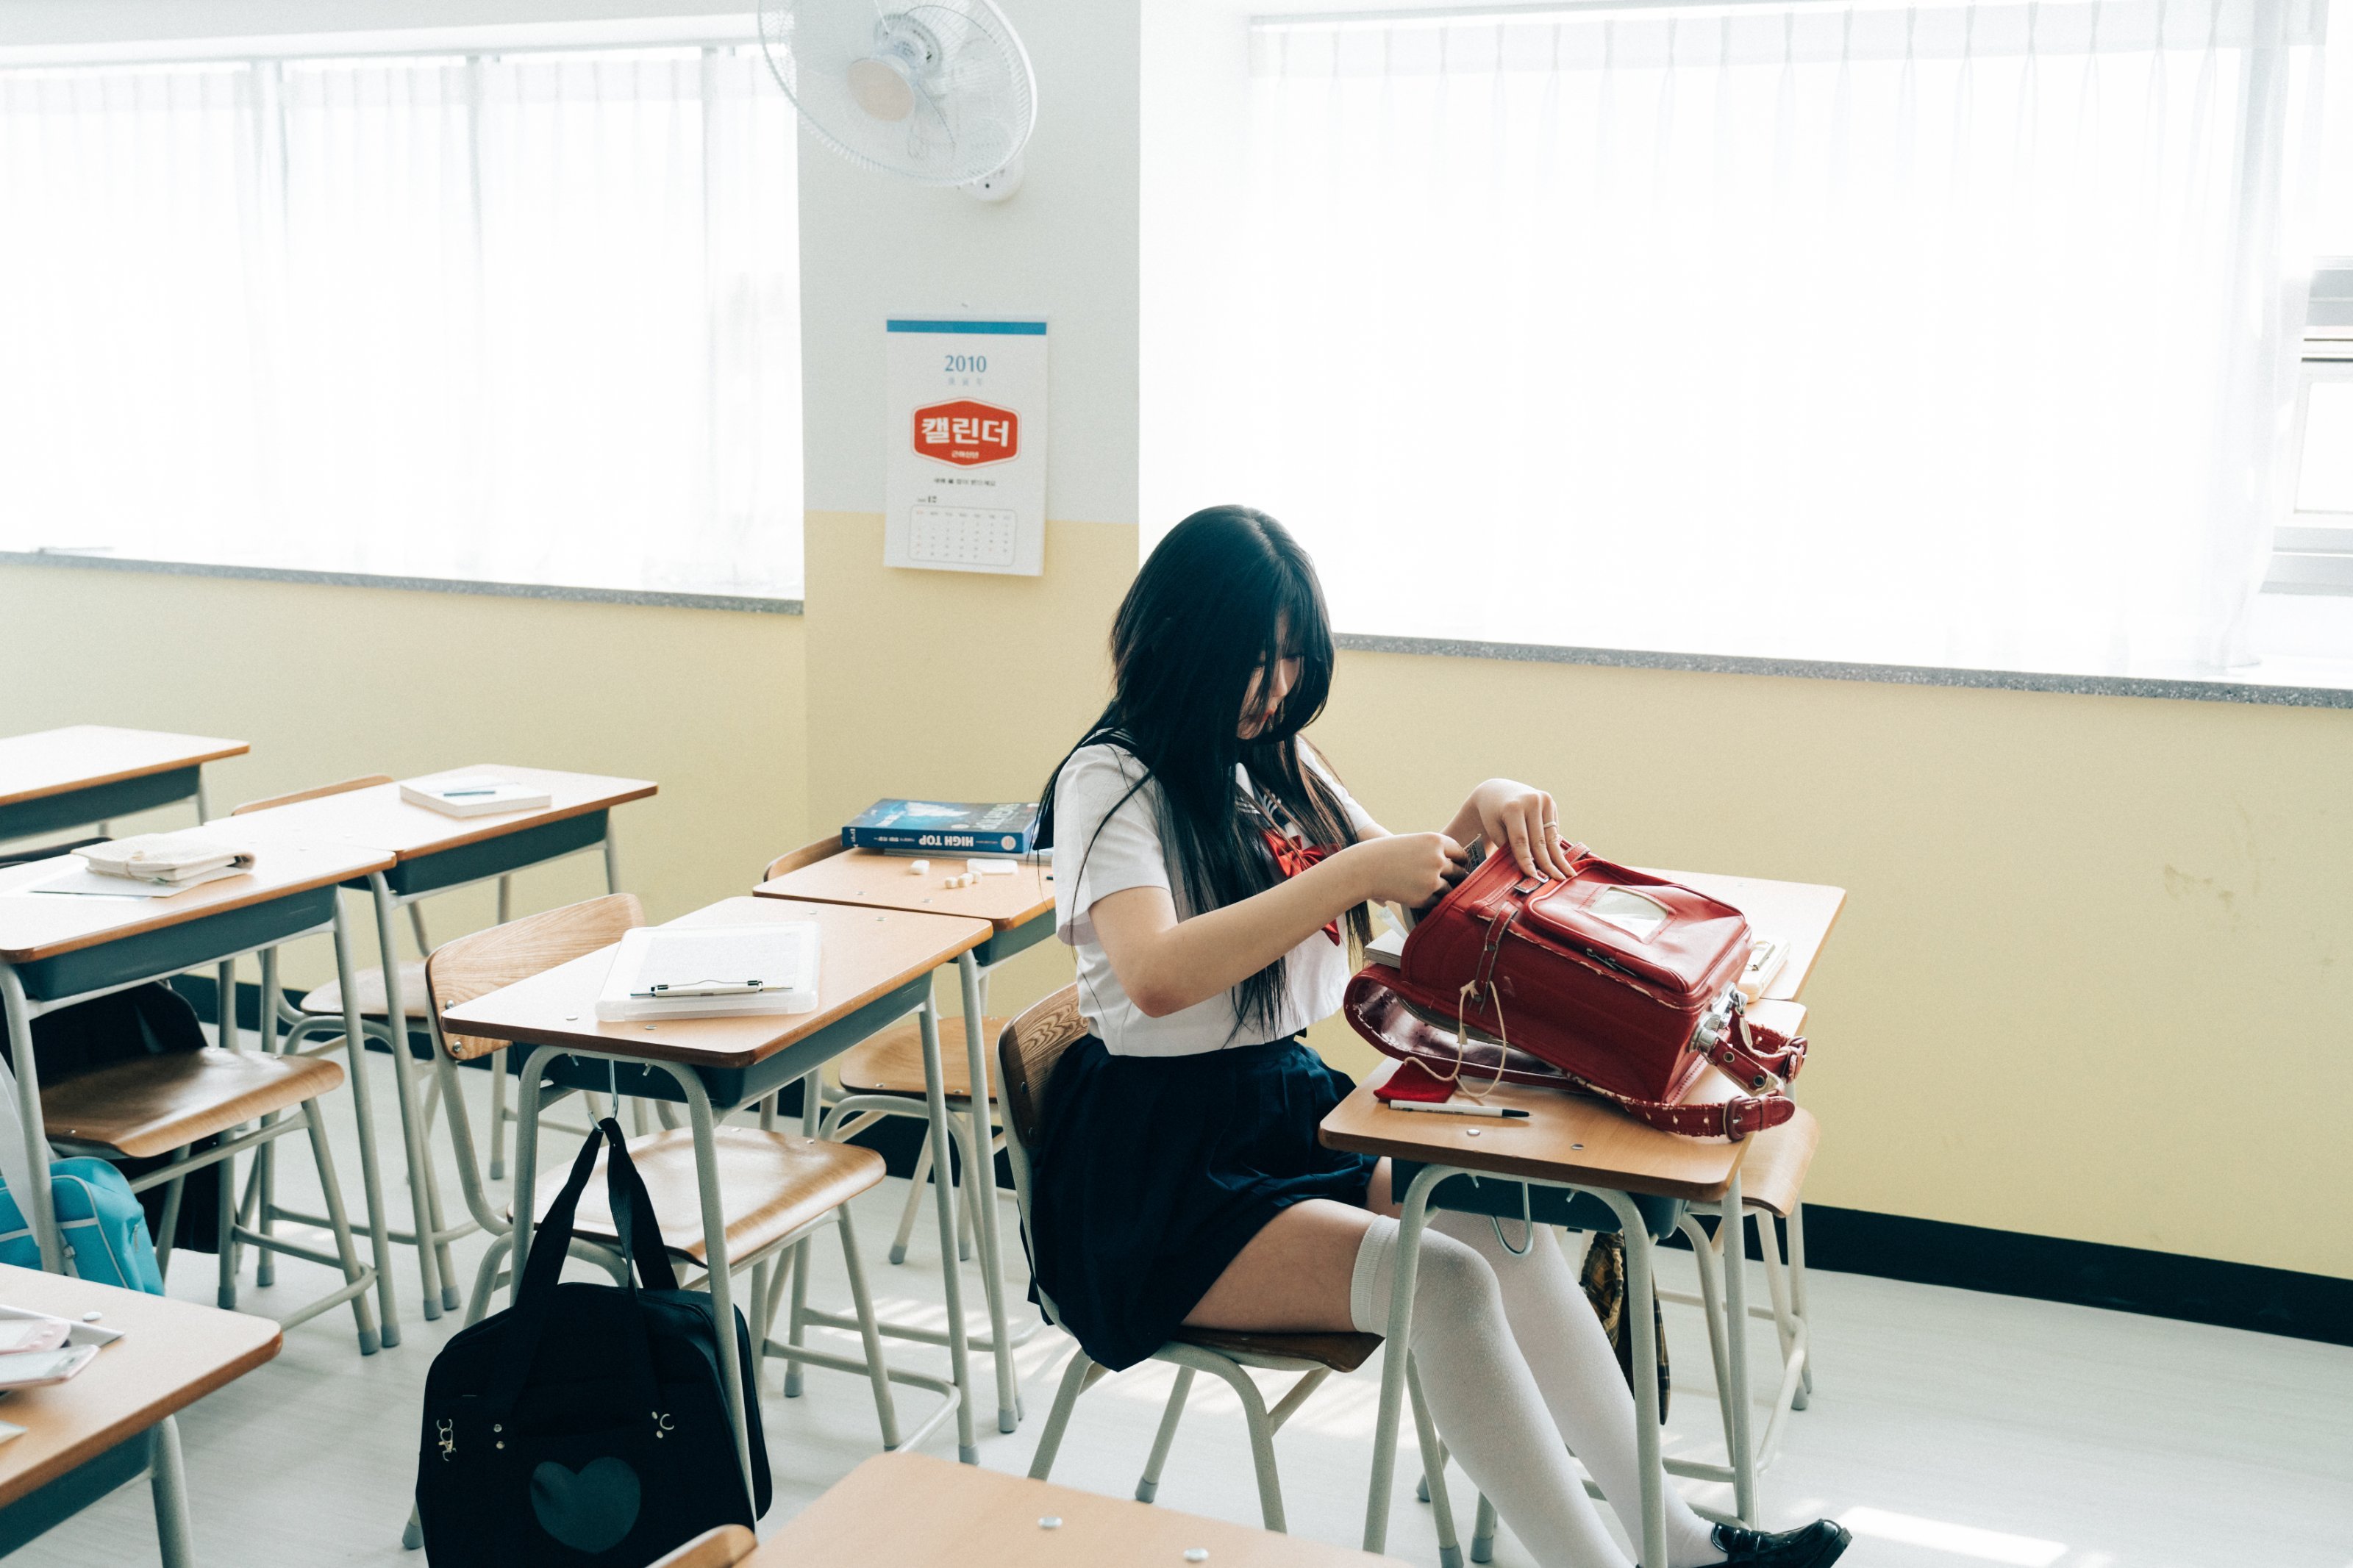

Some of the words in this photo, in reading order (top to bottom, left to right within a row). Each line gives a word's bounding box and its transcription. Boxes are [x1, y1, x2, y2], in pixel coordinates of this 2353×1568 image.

[944, 354, 987, 373] 2010
[921, 417, 1009, 447] 캘린더
[918, 834, 943, 845] TOP
[944, 835, 974, 847] HIGH
